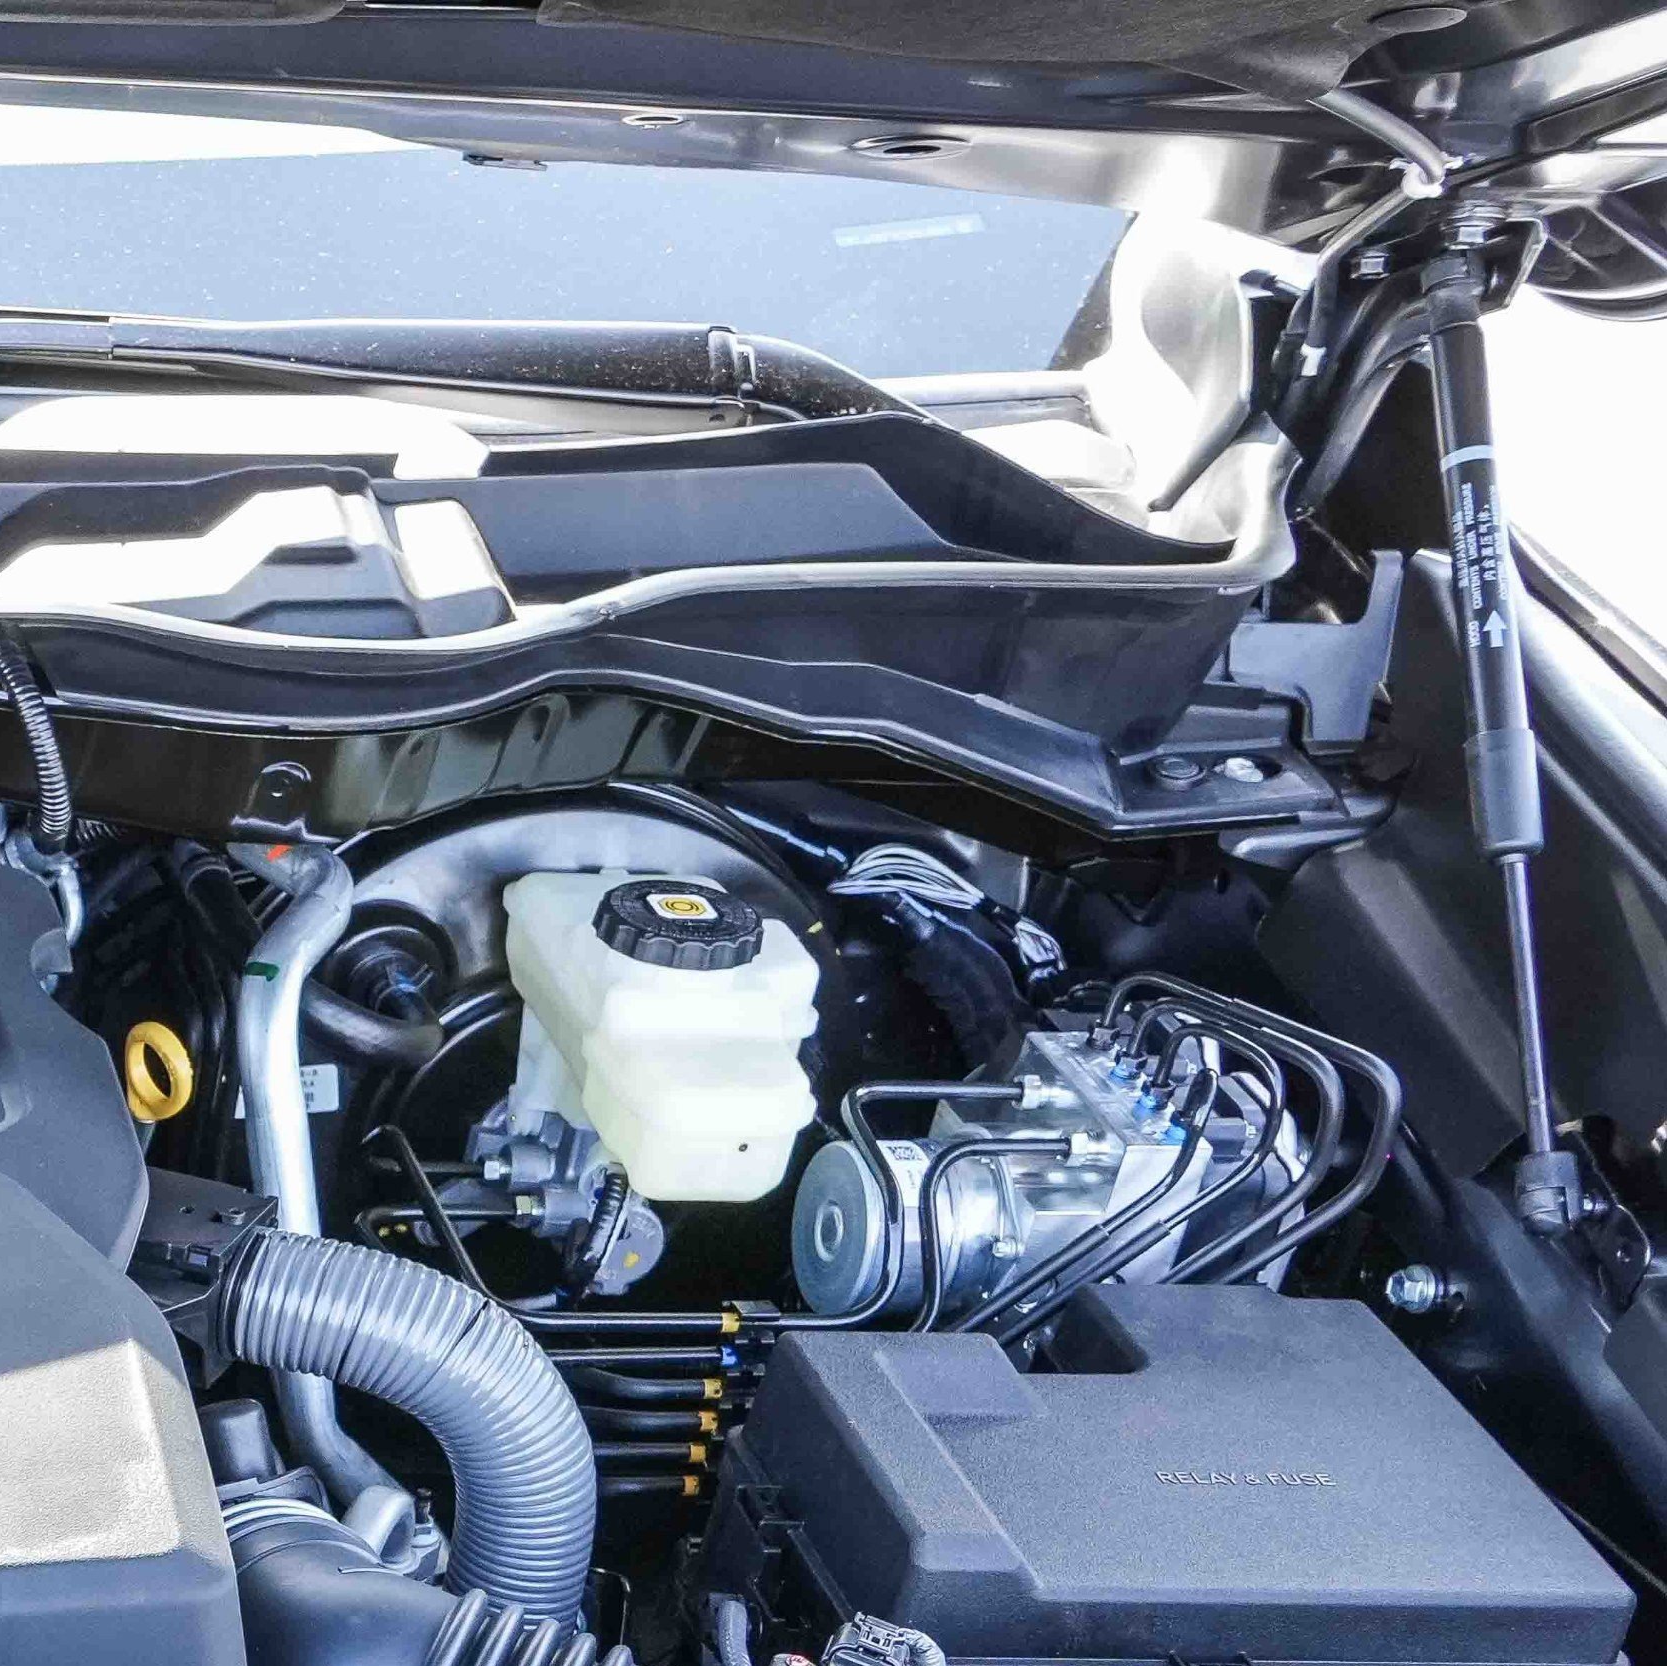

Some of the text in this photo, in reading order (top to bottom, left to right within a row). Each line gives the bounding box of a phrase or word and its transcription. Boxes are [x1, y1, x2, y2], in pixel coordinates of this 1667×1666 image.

[1461, 482, 1475, 526] PRESSURE
[1467, 530, 1478, 560] UNDER
[1469, 565, 1482, 610] CONTENTS
[1468, 620, 1481, 648] HOOD
[1156, 1471, 1338, 1487] RELAY & FUSE
